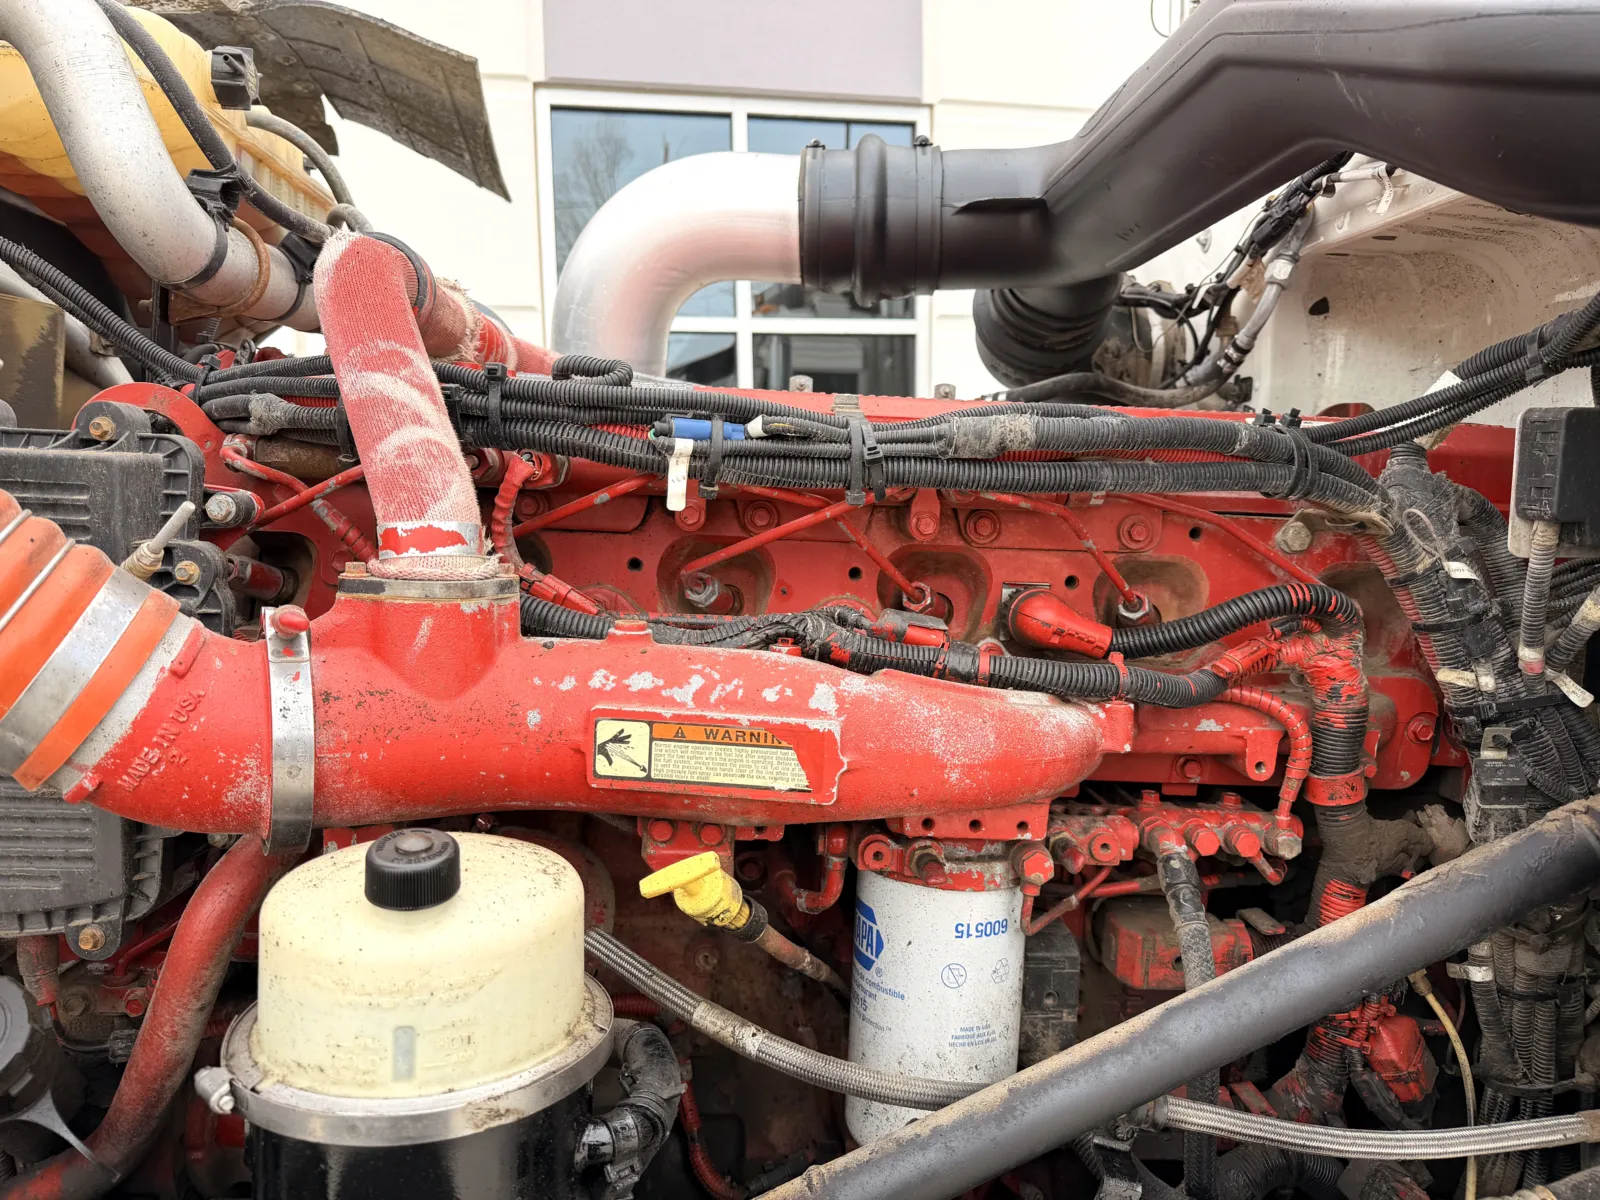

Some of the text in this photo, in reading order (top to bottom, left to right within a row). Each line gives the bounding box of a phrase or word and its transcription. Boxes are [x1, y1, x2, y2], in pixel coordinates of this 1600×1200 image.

[117, 746, 162, 792] MADE
[152, 722, 181, 748] IN
[854, 914, 875, 957] APA
[955, 918, 1008, 938] 600515
[865, 977, 905, 1001] combustible
